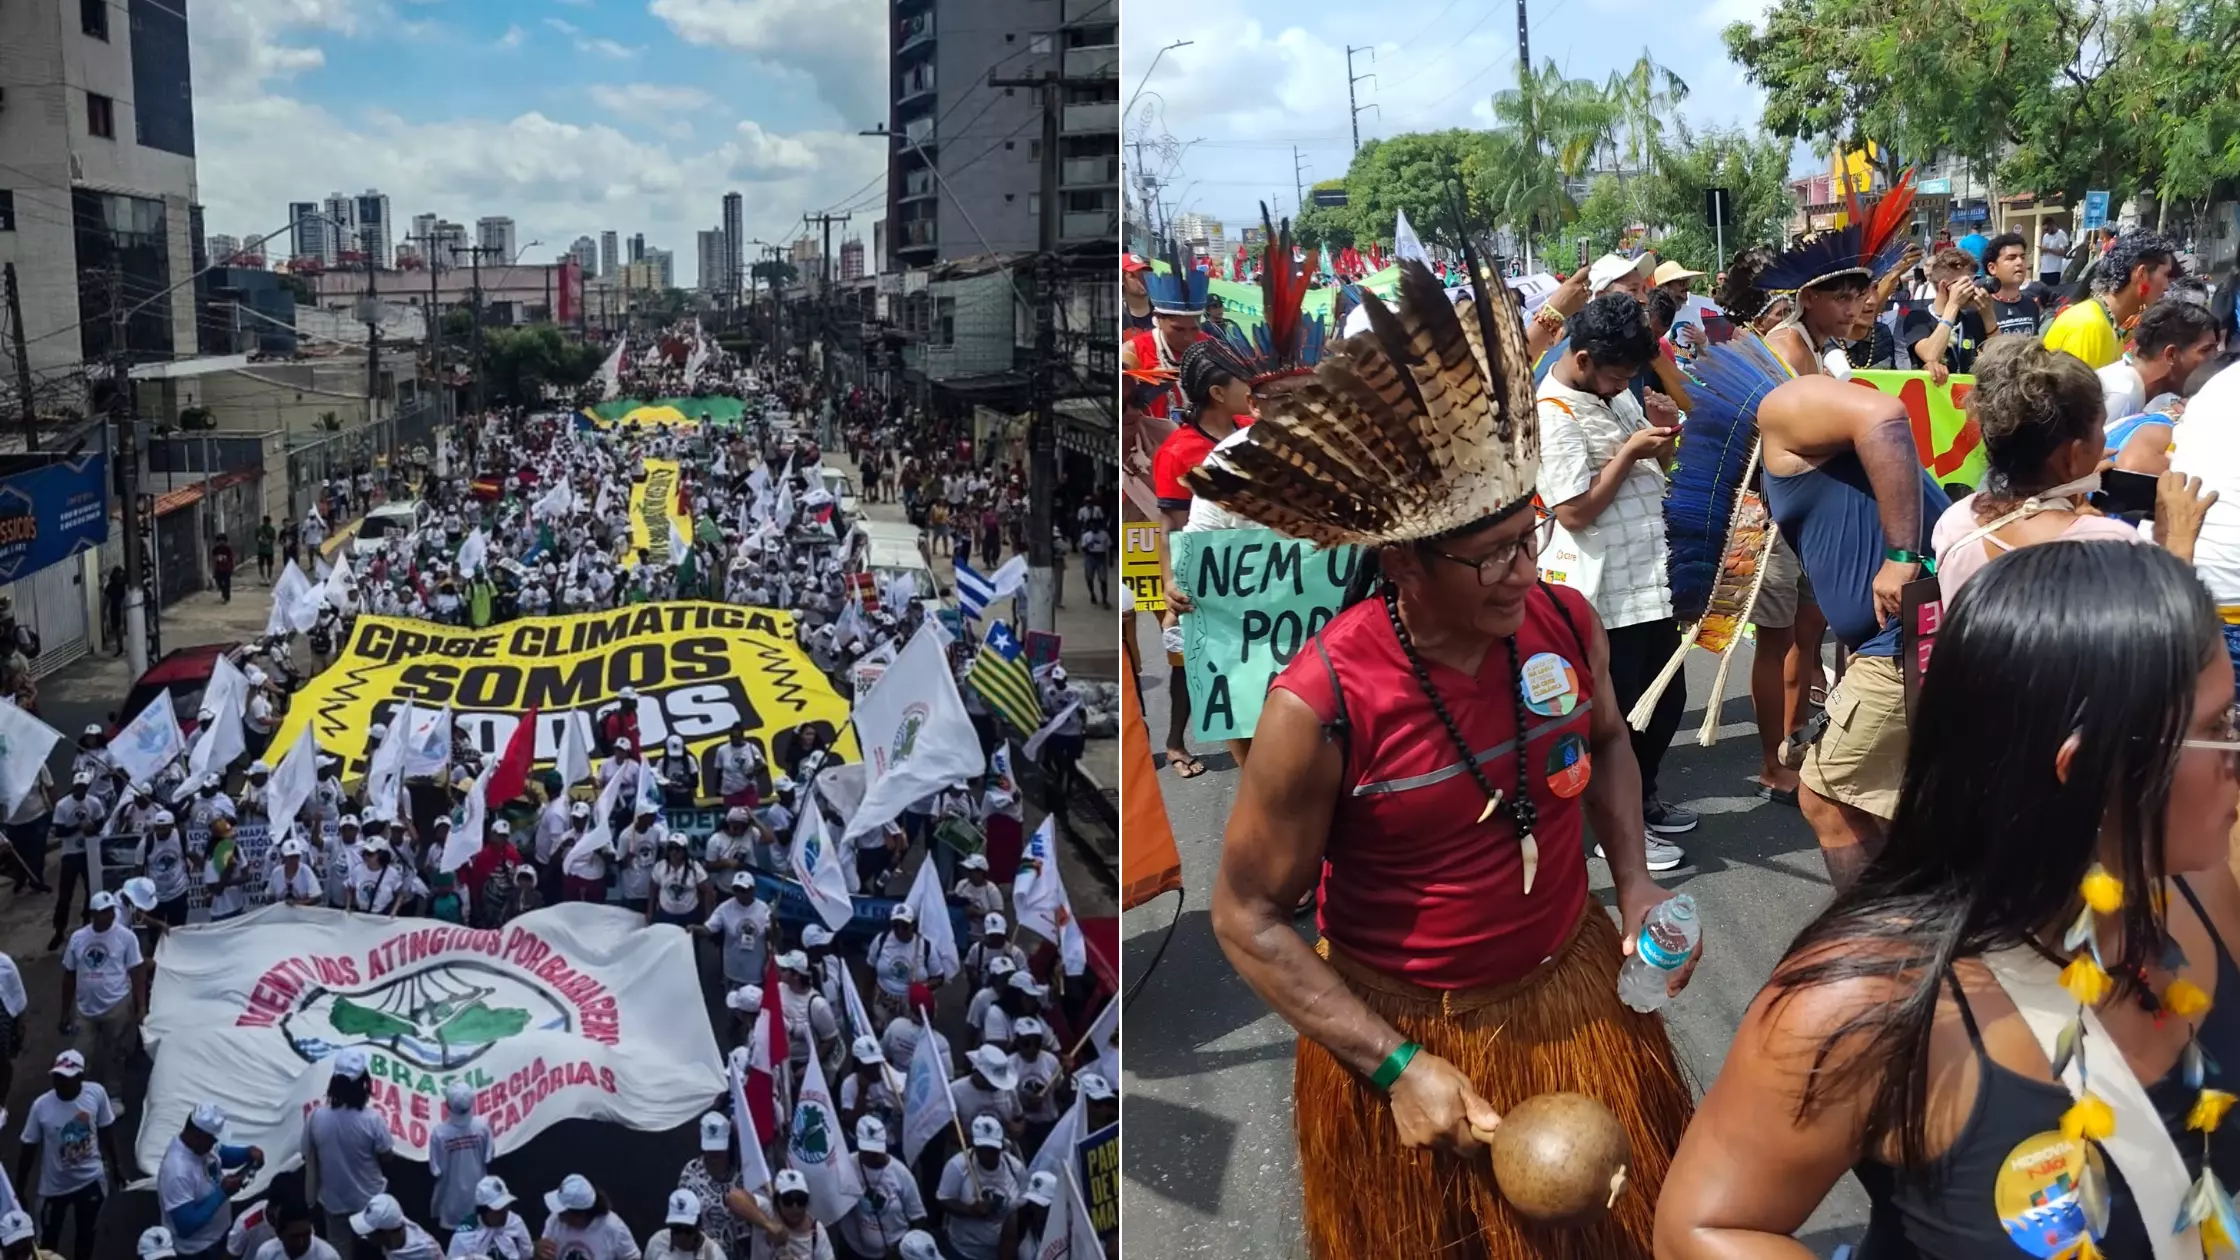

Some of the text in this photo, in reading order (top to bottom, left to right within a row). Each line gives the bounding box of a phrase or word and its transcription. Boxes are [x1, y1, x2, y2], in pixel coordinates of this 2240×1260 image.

[1122, 575, 1164, 598] PET
[1198, 542, 1357, 598] NEM U
[392, 635, 732, 709] SOMOS
[1202, 660, 1234, 732] À
[501, 926, 551, 969] POR
[369, 1052, 494, 1096] BRASIL
[411, 1092, 430, 1120] E
[489, 1061, 617, 1138] CADORIAS
[1087, 1136, 1119, 1176] PAR
